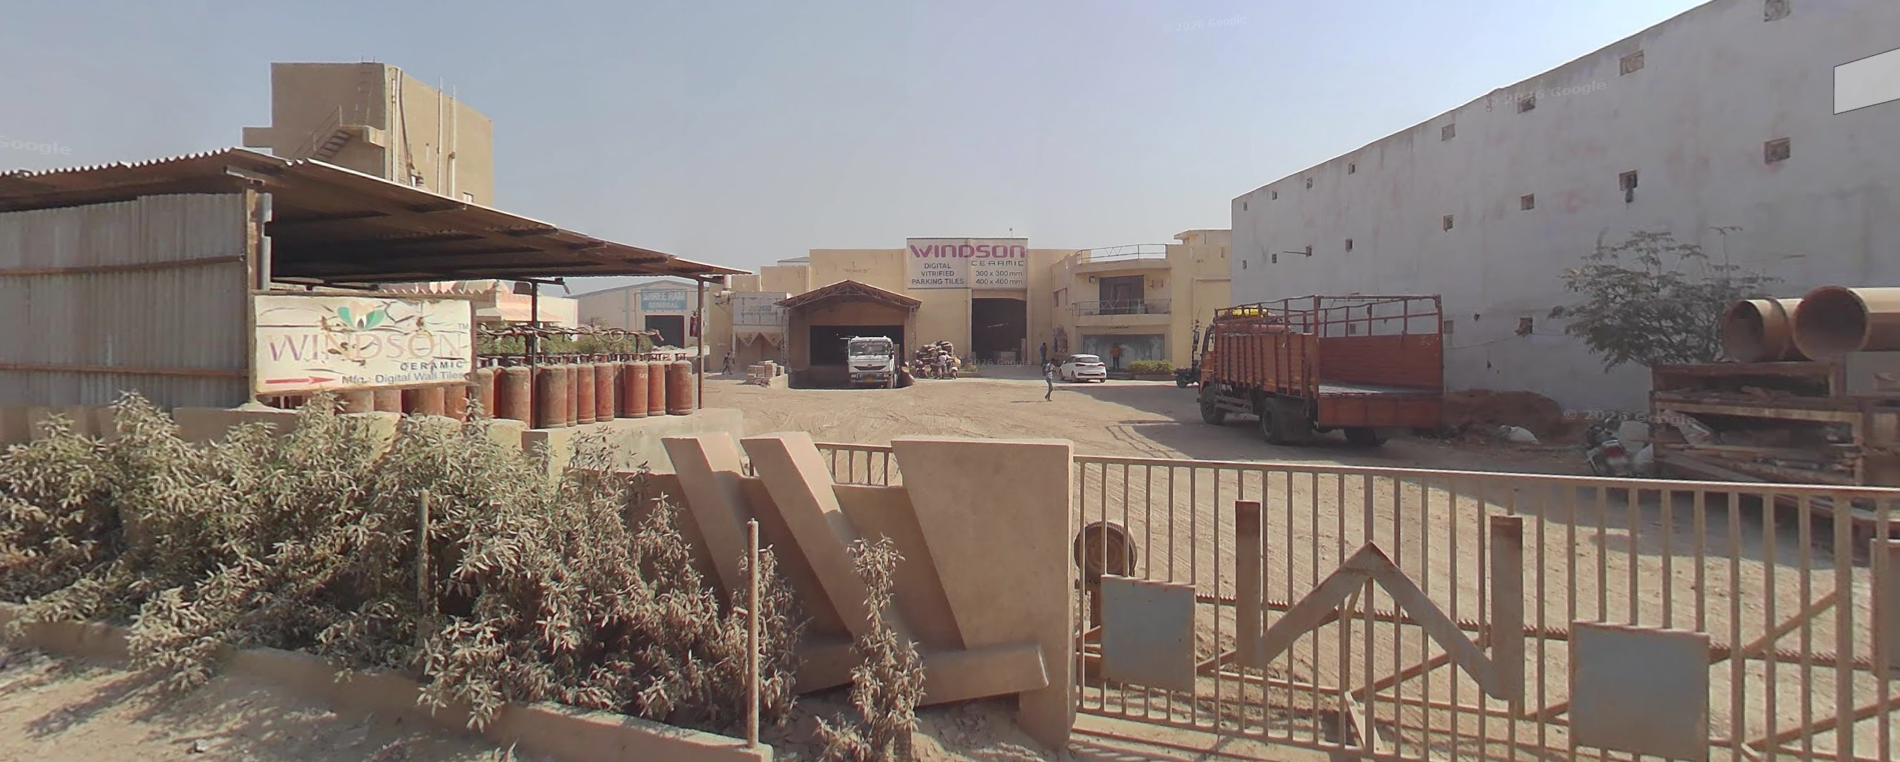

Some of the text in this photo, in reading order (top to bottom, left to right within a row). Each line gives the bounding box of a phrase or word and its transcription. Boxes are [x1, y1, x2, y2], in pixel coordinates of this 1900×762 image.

[909, 244, 1026, 258] WINDSON
[924, 262, 952, 270] DIGITAL
[945, 277, 965, 285] TILES
[267, 333, 462, 362] WINDSON
[399, 361, 464, 371] CERAMIC
[375, 372, 411, 383] Digital
[413, 371, 438, 381] Wall
[440, 370, 465, 379] Tiles
